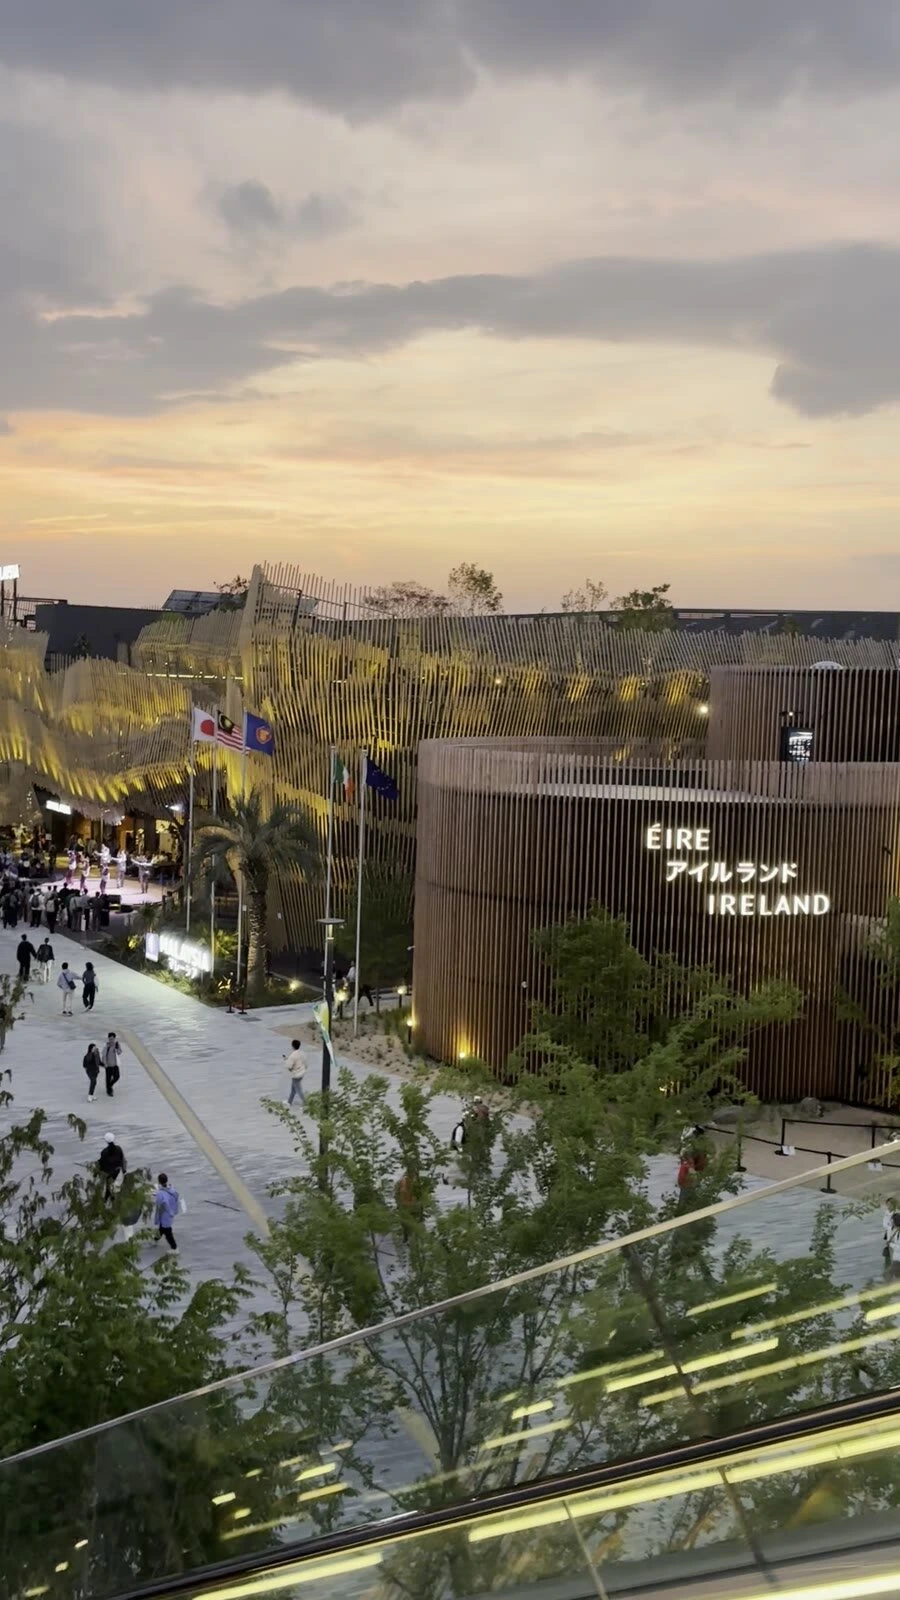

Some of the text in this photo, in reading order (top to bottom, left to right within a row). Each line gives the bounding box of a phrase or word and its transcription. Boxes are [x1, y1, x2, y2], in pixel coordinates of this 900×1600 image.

[646, 823, 711, 850] ÉIRE
[666, 861, 797, 883] アイルランド
[708, 894, 831, 916] IRELAND
